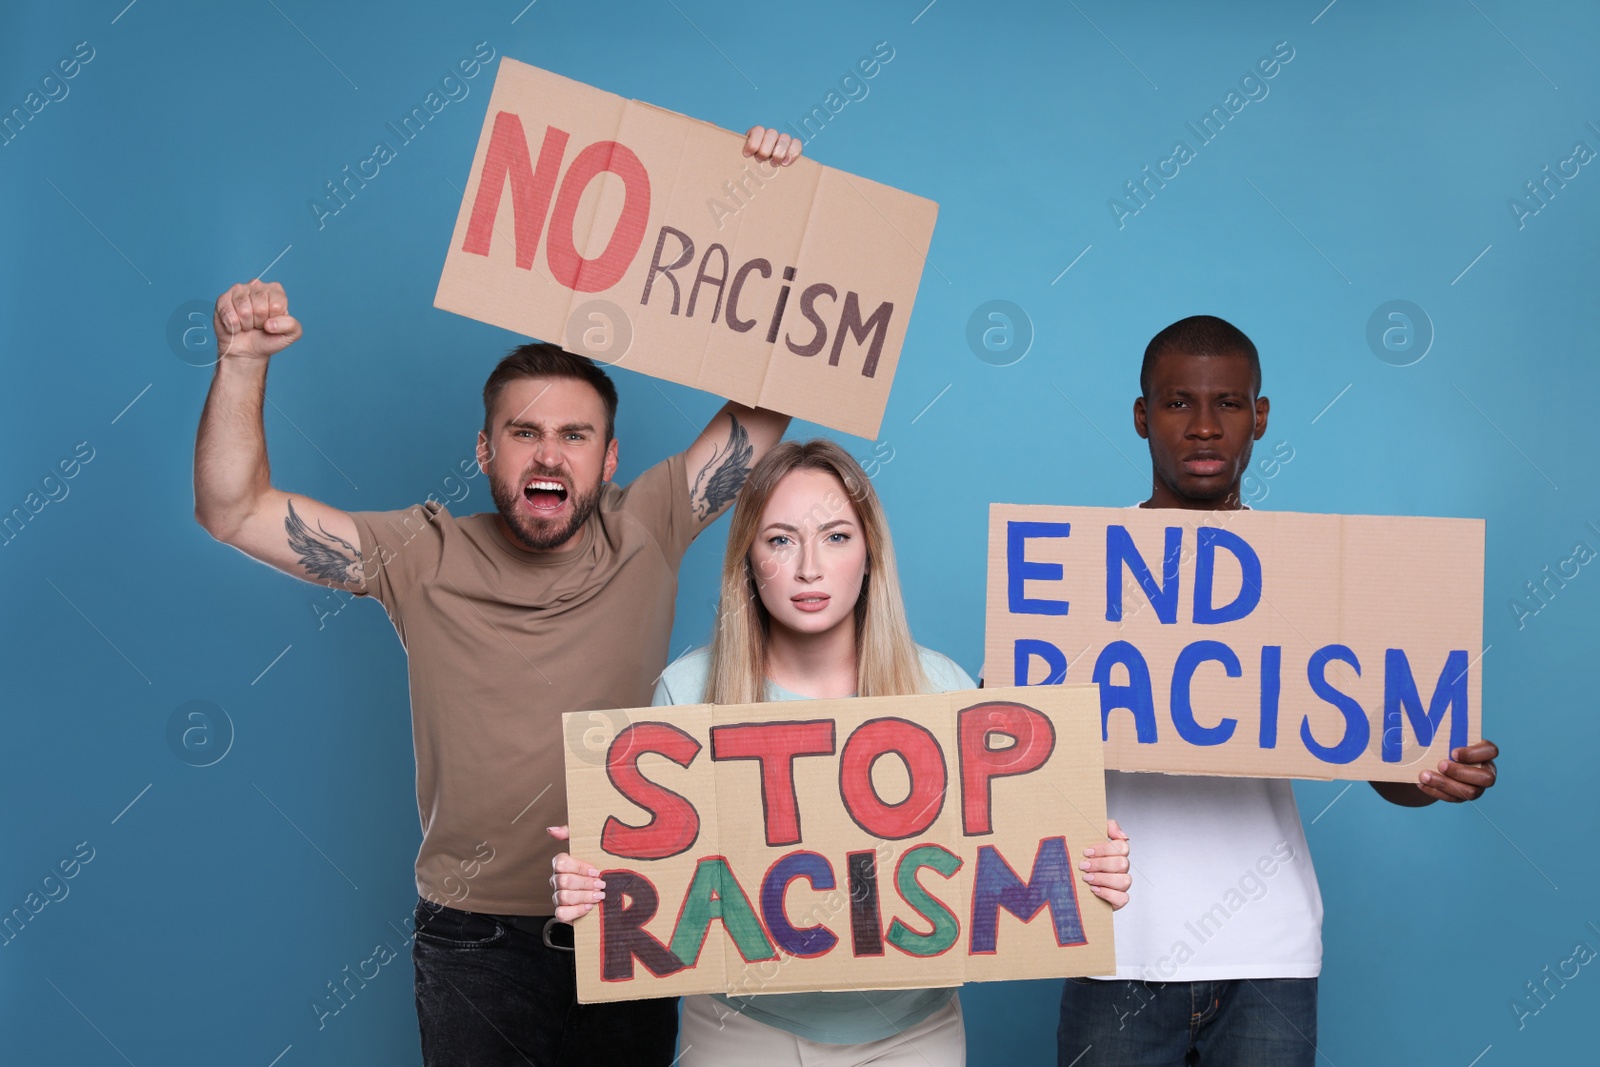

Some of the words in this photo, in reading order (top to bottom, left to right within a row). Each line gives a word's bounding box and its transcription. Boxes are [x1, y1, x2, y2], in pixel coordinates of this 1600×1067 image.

[462, 111, 651, 292] NO
[1007, 521, 1262, 625] END
[601, 701, 1056, 860] STOP
[600, 836, 1089, 982] RACISM
